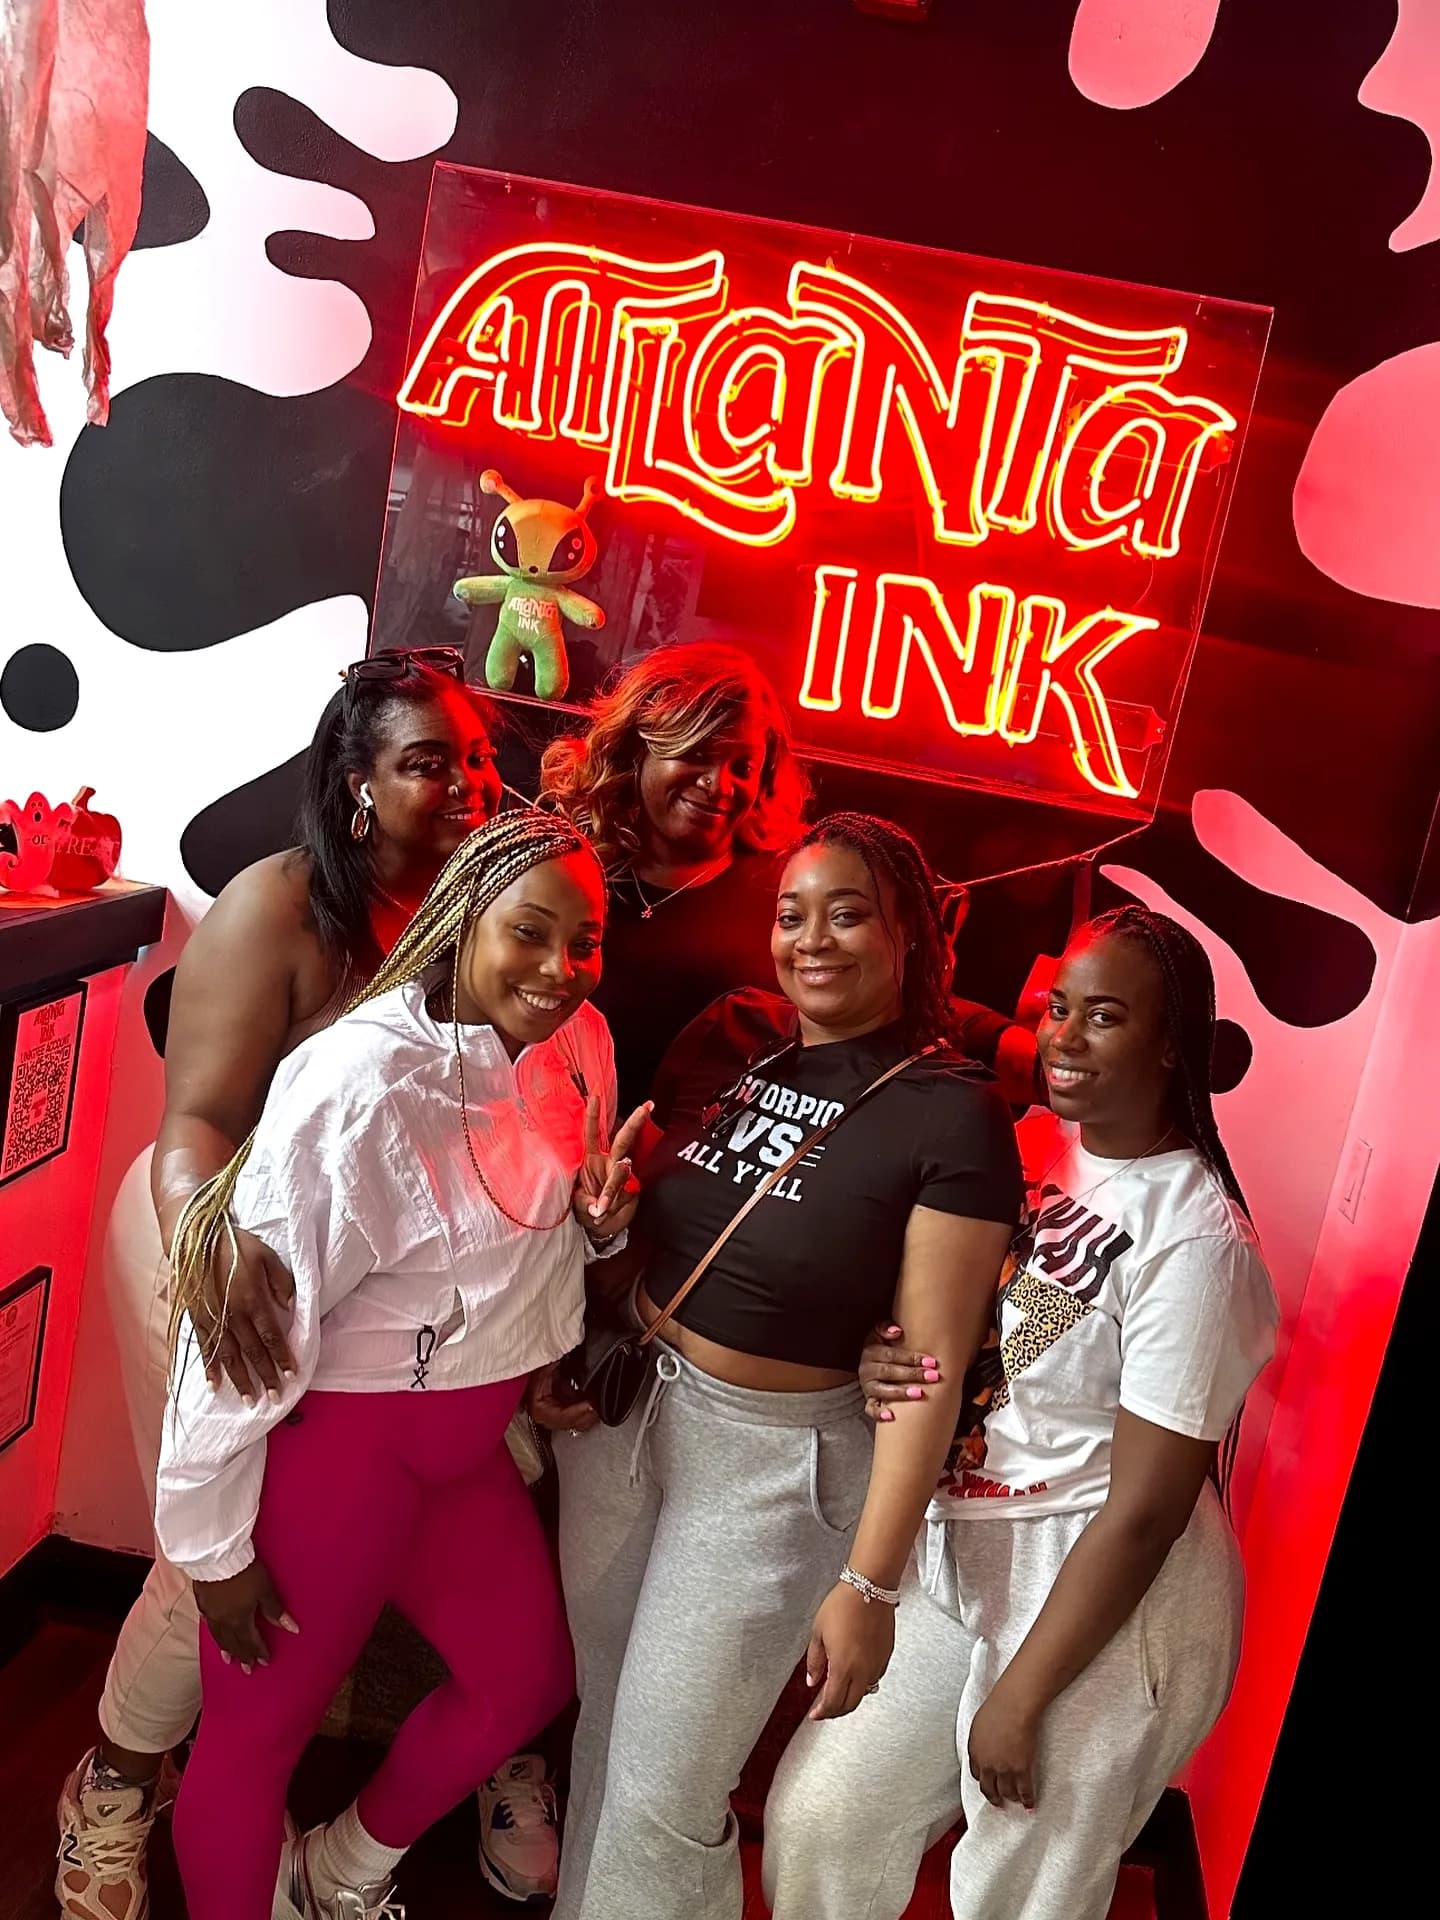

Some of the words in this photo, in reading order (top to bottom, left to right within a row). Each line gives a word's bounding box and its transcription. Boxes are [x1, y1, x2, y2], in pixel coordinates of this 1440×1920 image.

[517, 616, 540, 635] INK
[799, 564, 1159, 797] INK
[677, 1141, 724, 1174] ALL
[727, 1110, 804, 1168] VS
